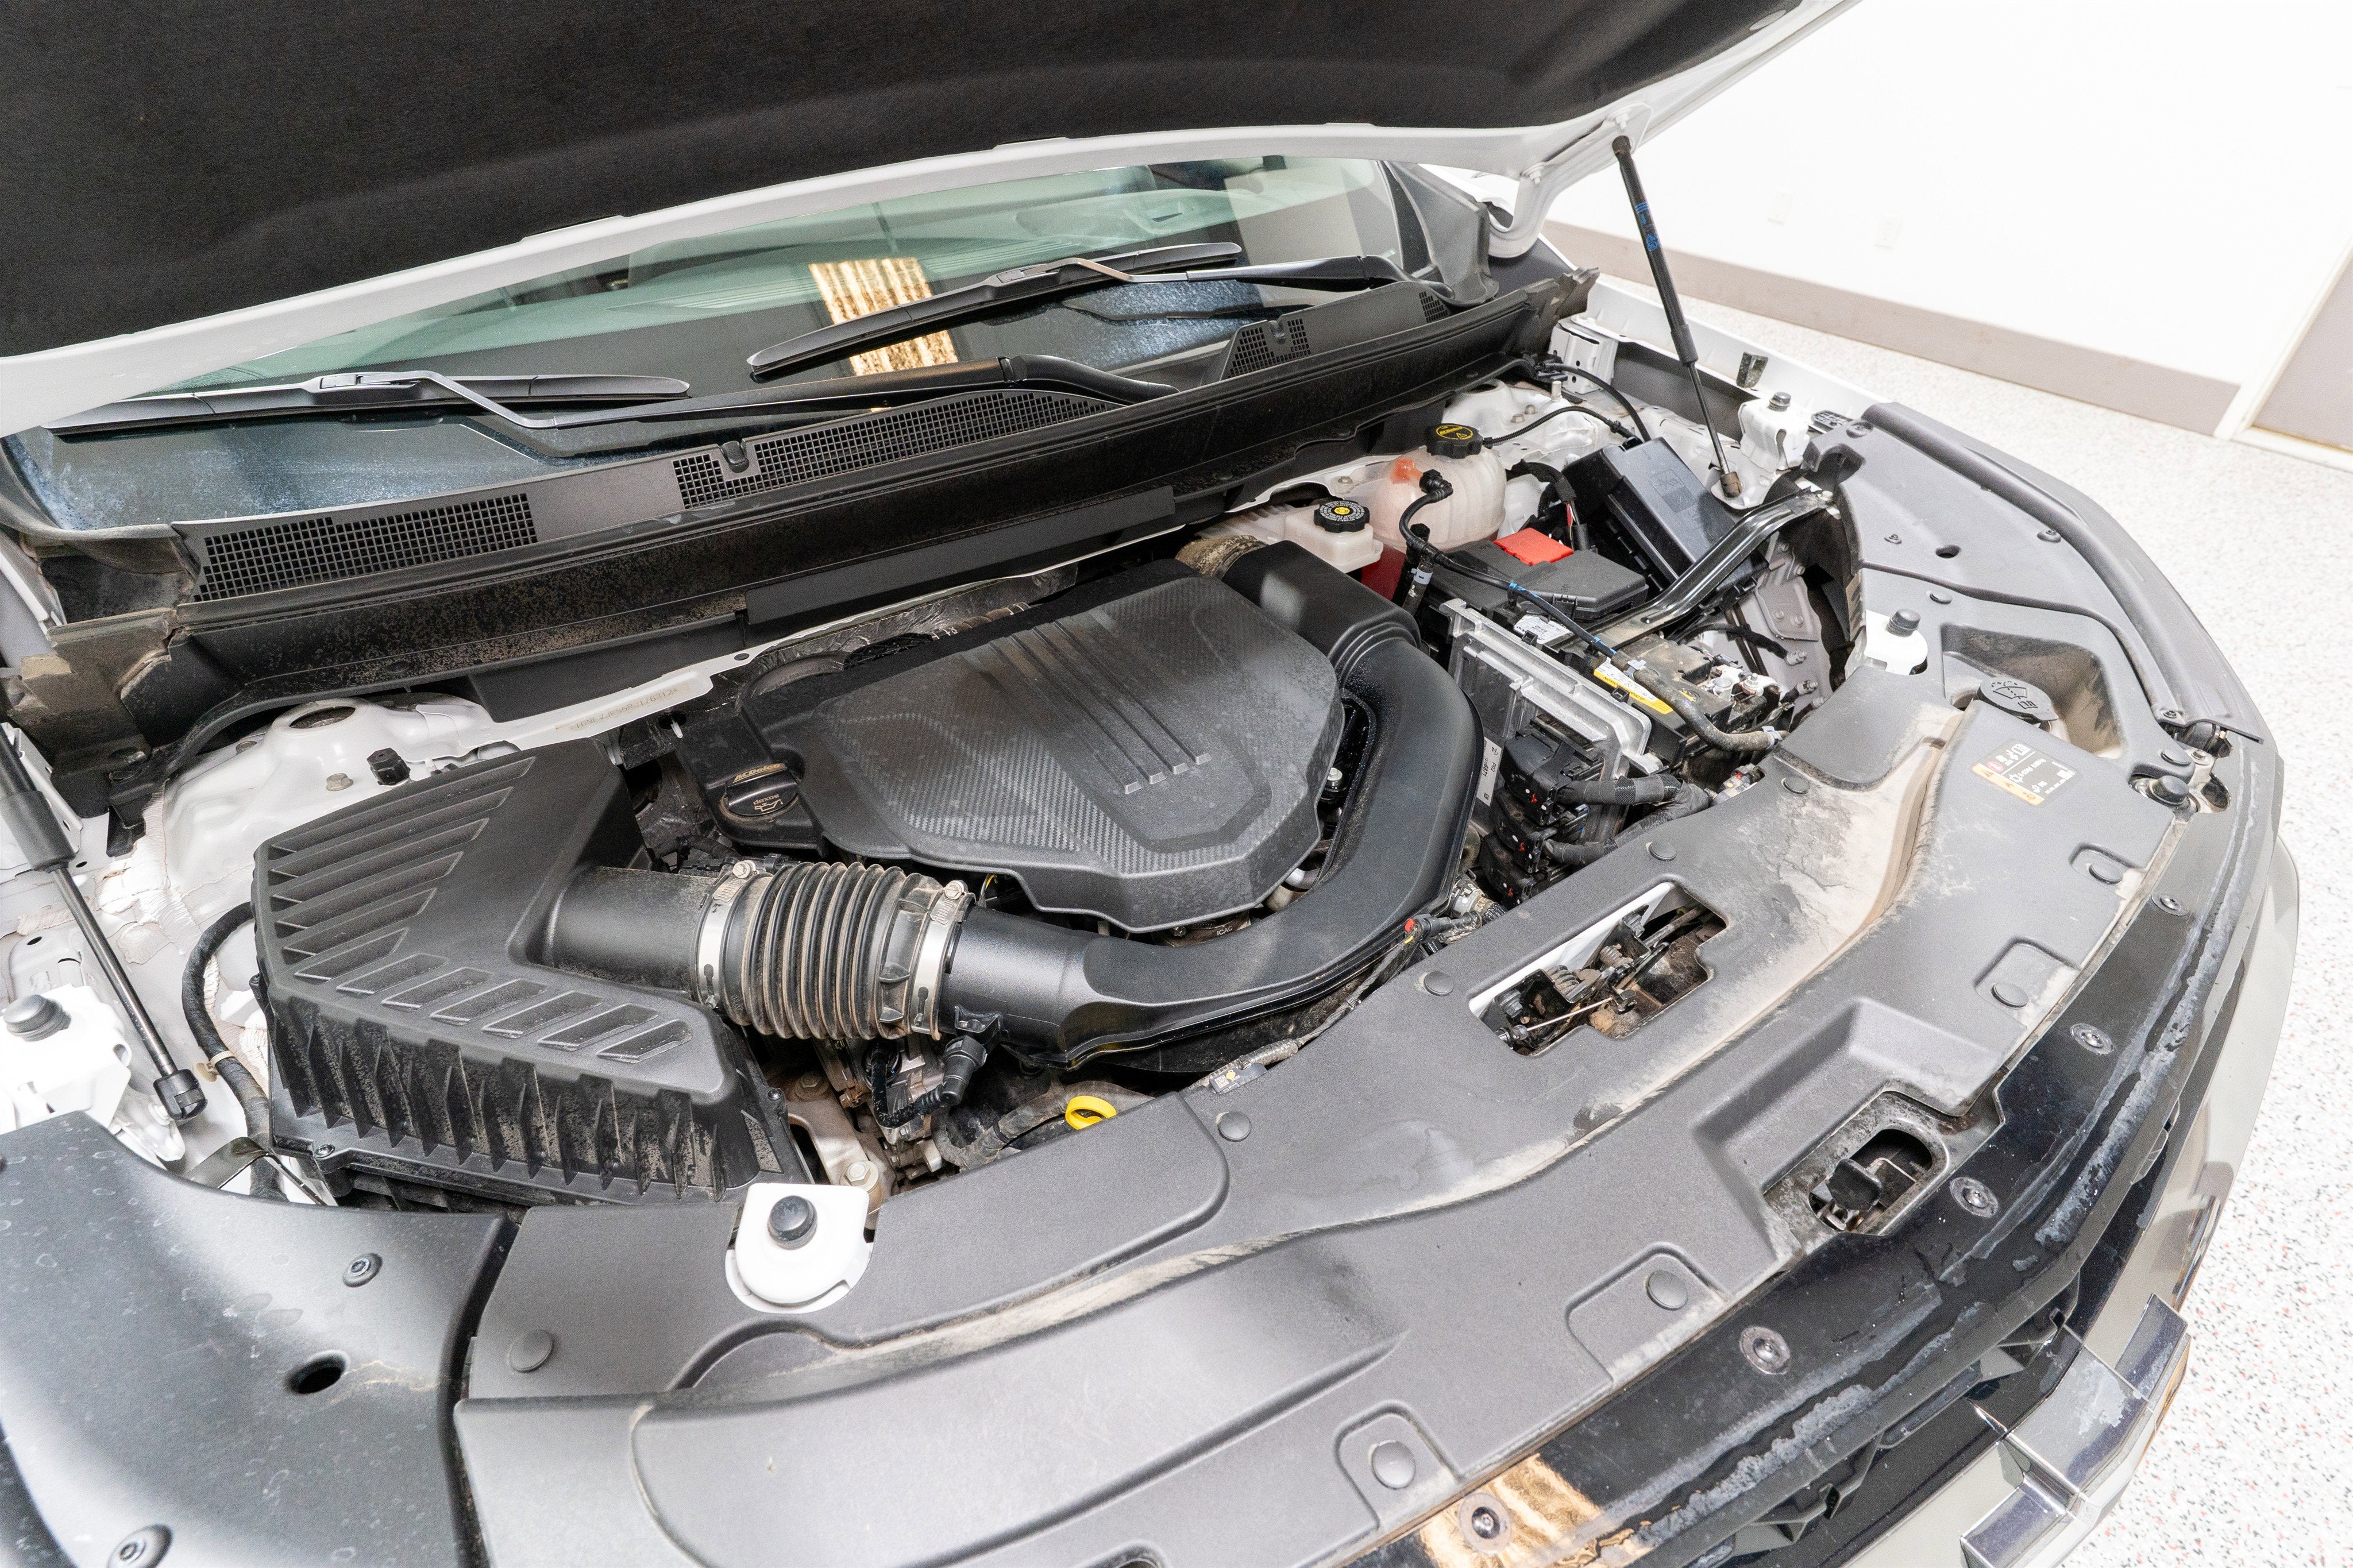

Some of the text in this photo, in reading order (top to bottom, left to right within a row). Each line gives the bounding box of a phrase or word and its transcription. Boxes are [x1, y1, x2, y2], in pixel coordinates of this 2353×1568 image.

[734, 764, 781, 782] ACDelco
[753, 794, 780, 805] dexos
[1217, 925, 1233, 936] ICAC
